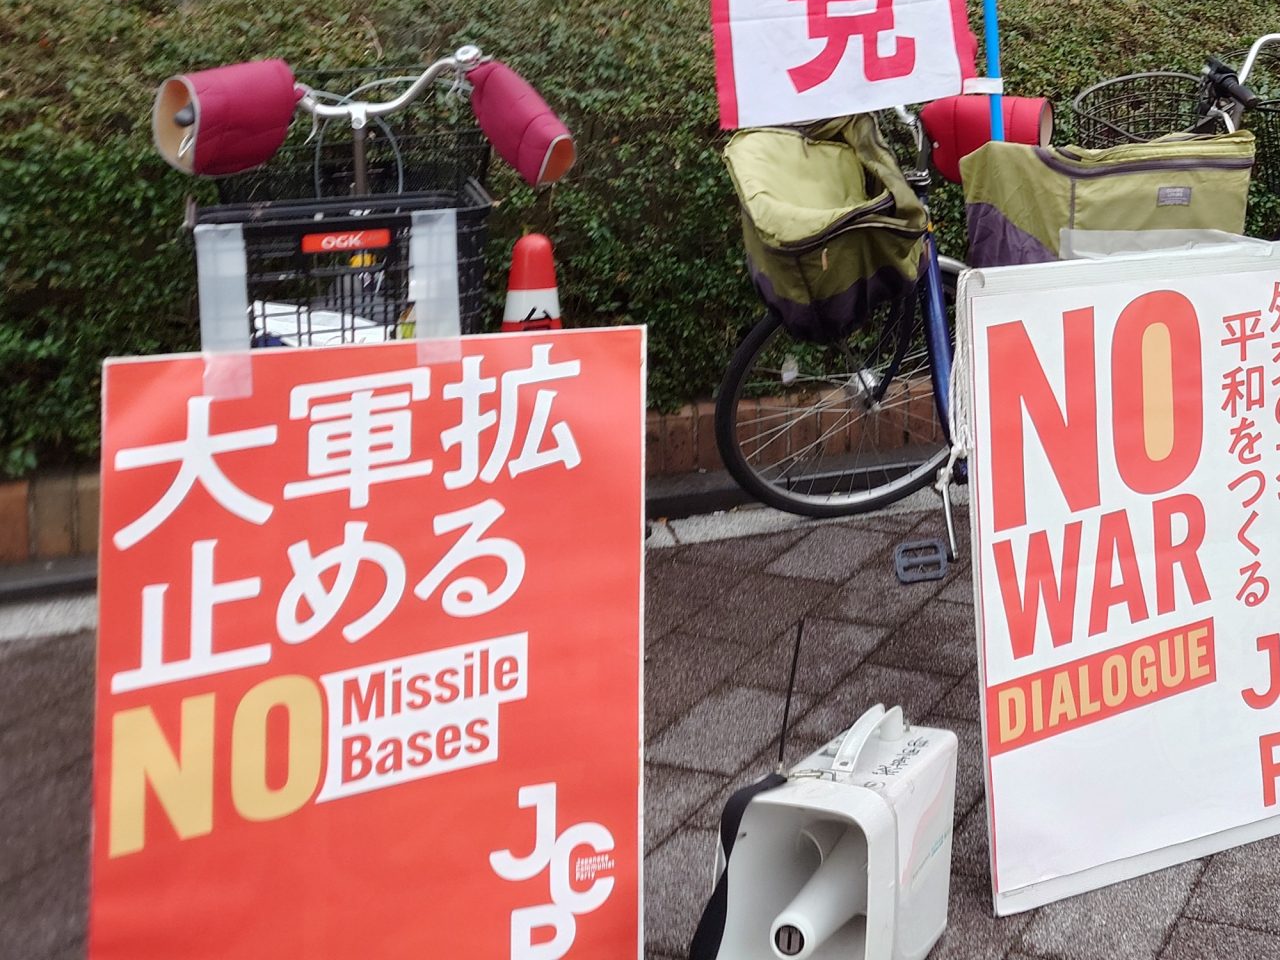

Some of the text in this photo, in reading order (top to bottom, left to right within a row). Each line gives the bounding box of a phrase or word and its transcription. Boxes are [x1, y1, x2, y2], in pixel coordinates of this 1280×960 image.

[321, 231, 365, 250] OGK
[113, 342, 582, 551] 大軍拡
[986, 289, 1204, 533] NO
[1220, 310, 1271, 609] 平和をつくる
[110, 498, 527, 694] 止める
[991, 493, 1212, 661] WAR
[108, 648, 520, 860] NO Missile
[341, 713, 491, 783] Bases
[998, 627, 1211, 744] DIALOGUE
